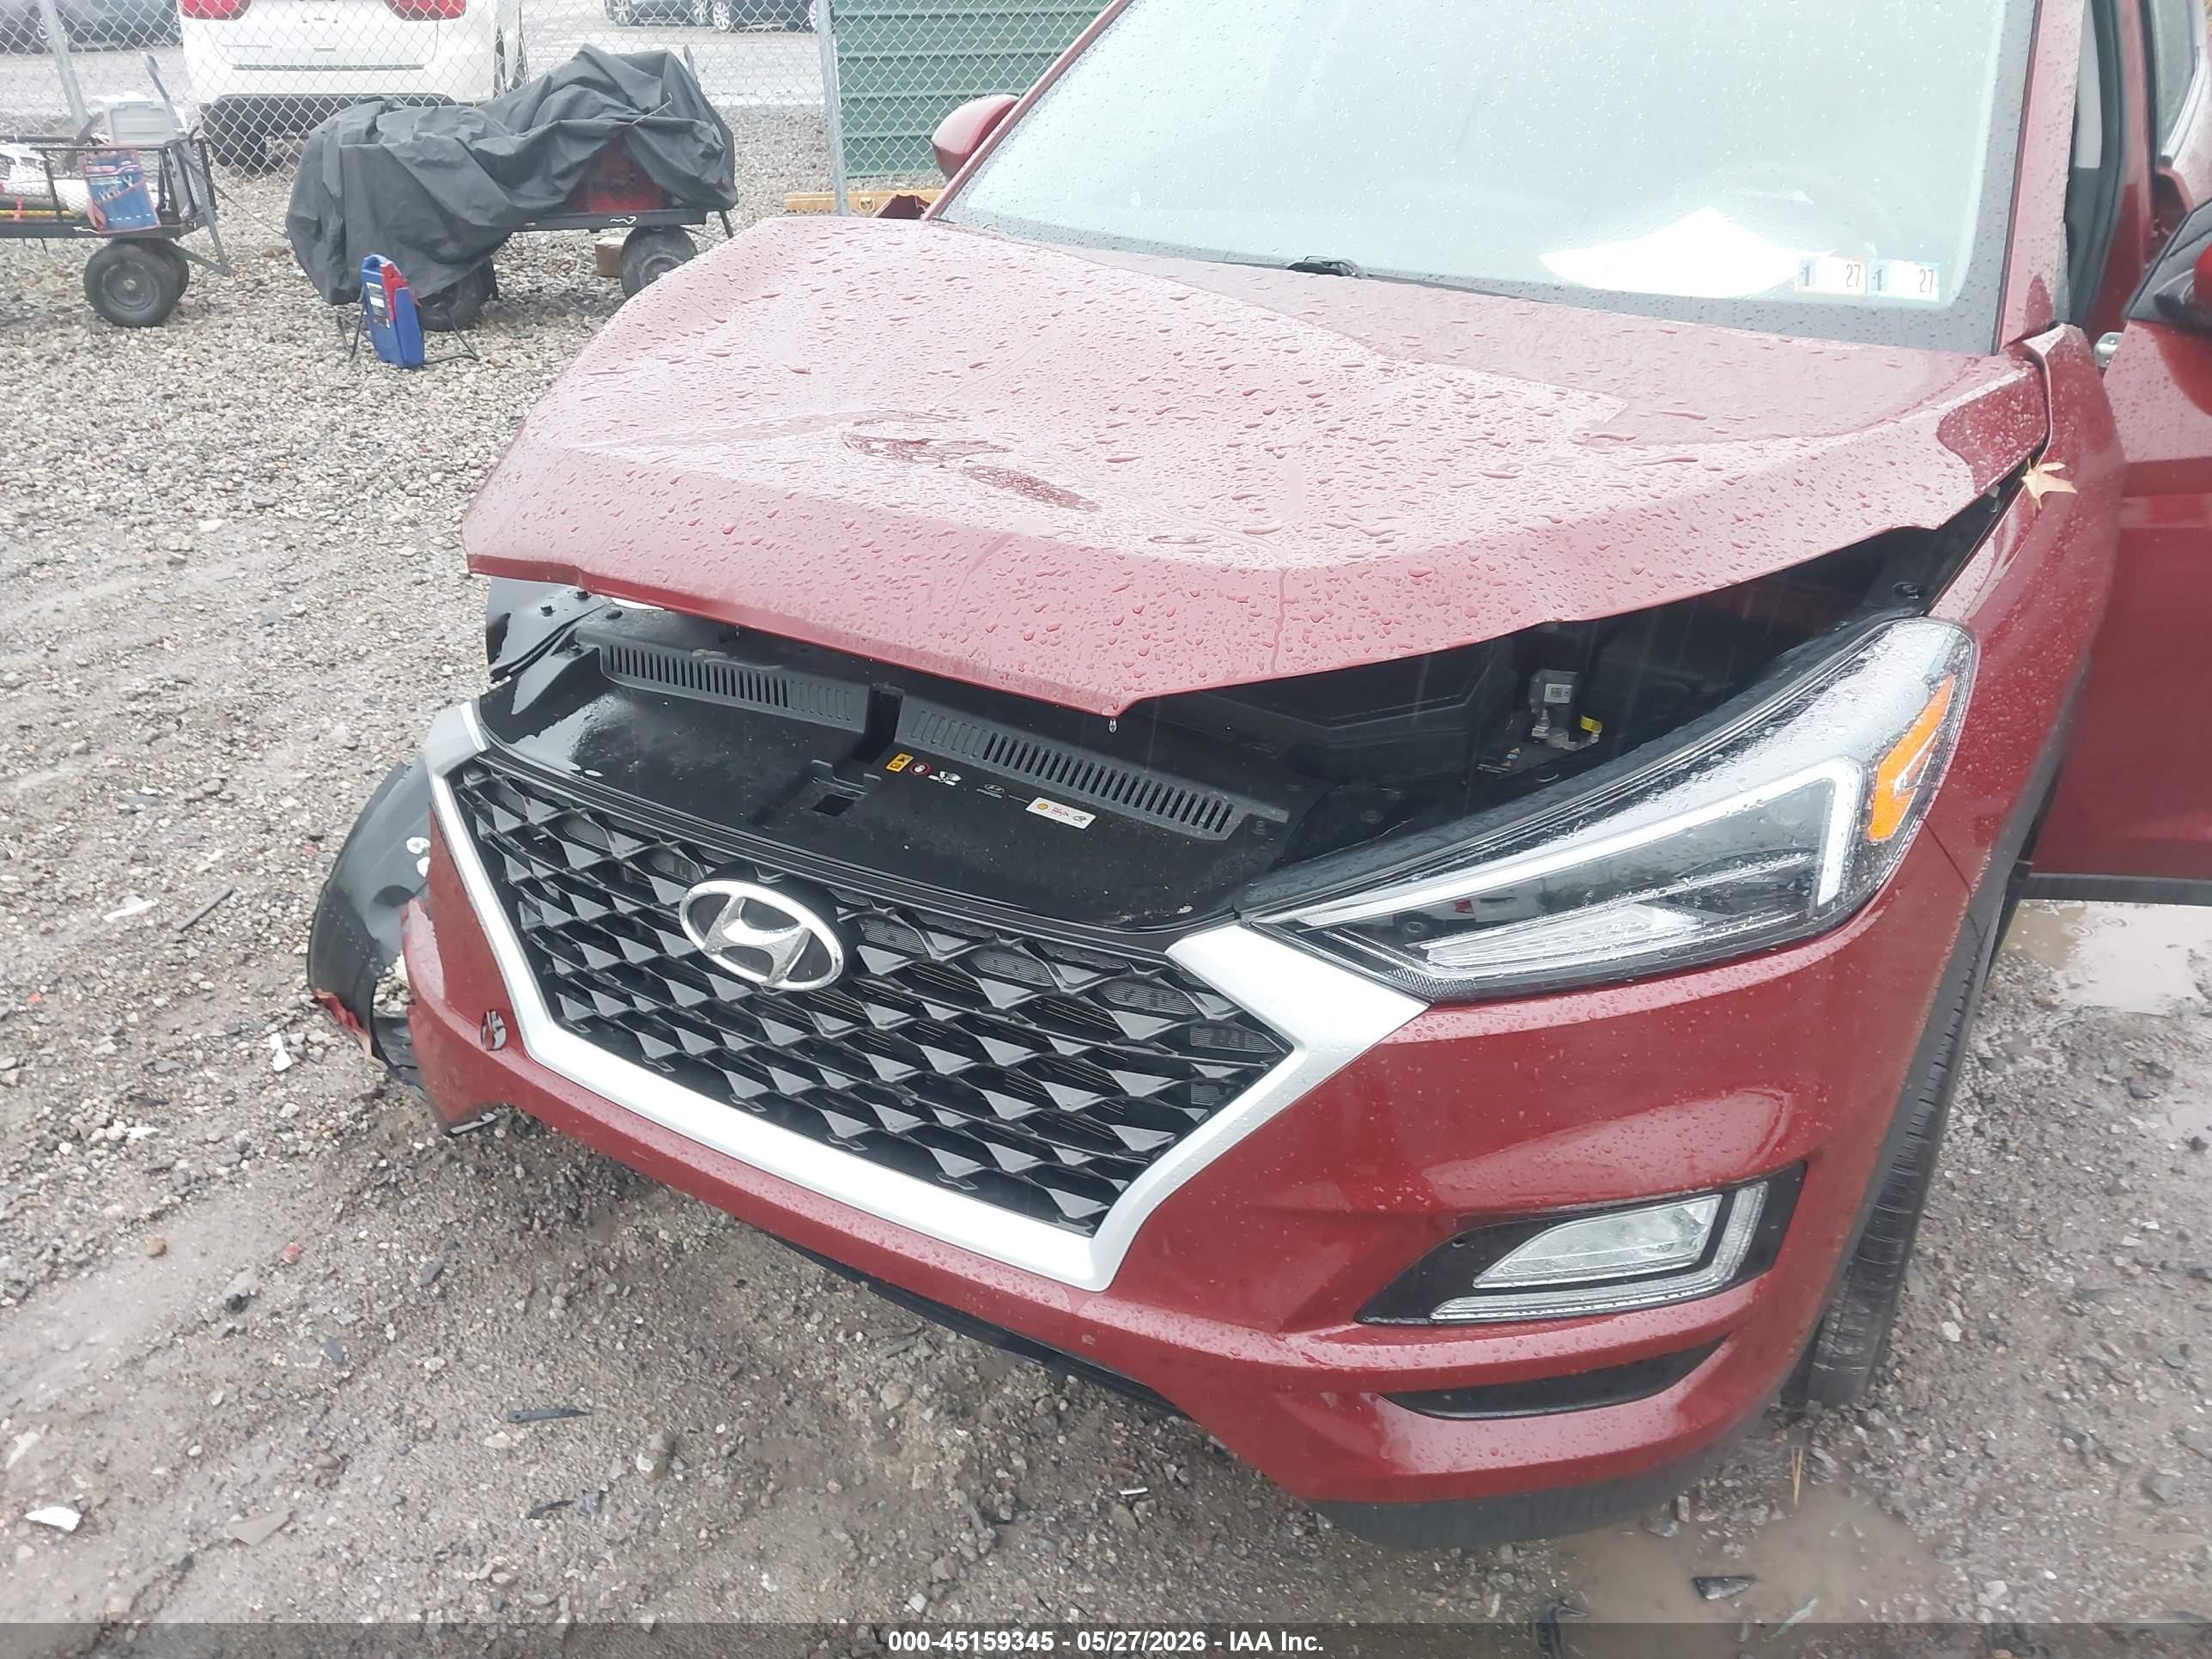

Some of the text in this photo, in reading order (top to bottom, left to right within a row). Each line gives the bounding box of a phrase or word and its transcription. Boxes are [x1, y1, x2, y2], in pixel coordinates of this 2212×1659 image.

[1802, 264, 1862, 288] 1 27
[1875, 268, 1935, 294] 1 27
